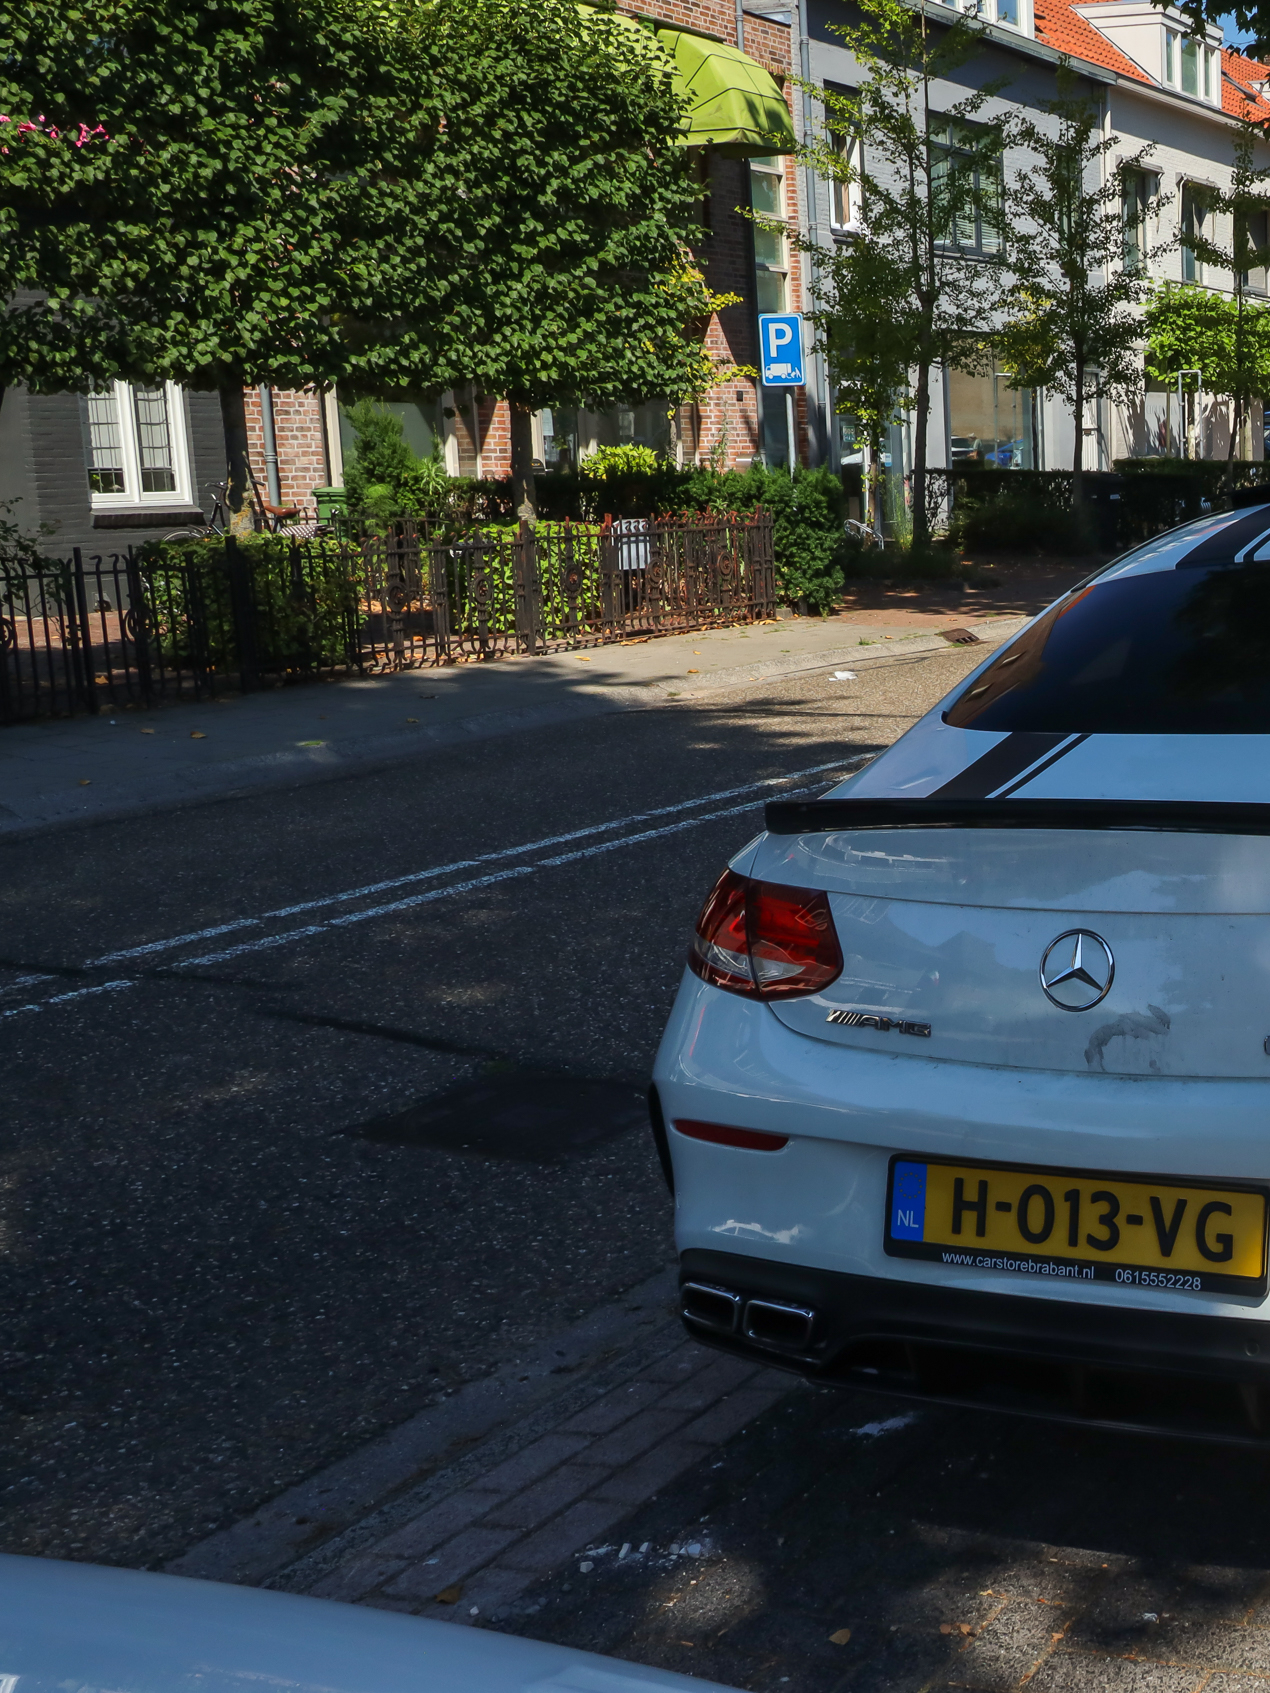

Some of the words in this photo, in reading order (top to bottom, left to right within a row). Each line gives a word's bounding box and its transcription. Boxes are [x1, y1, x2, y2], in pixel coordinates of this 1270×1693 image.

[768, 323, 793, 357] P
[856, 1012, 932, 1037] AMG
[897, 1209, 919, 1228] NL
[952, 1177, 1234, 1263] H-013-VG
[942, 1251, 1095, 1280] www.carstorebrabant.nl
[1115, 1268, 1201, 1291] 0615552228
